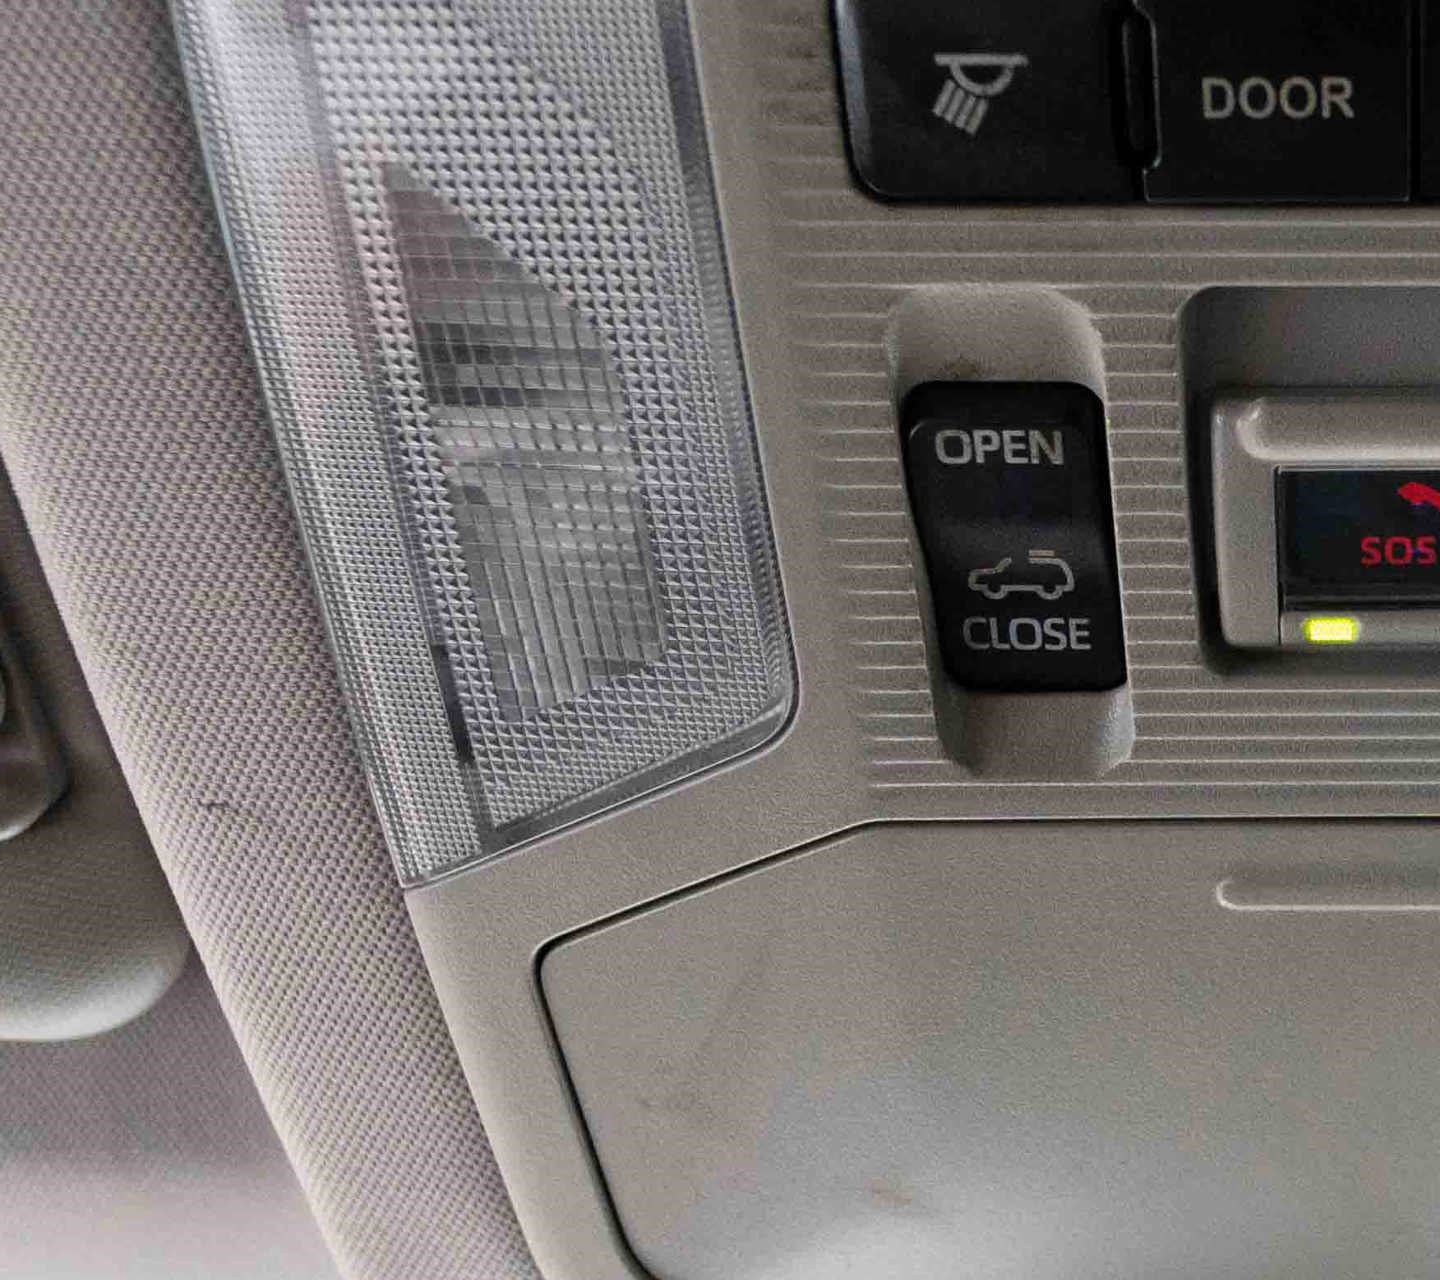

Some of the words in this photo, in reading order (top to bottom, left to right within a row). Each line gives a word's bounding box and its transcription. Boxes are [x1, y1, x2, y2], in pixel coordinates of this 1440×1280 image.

[1201, 76, 1354, 119] DOOR
[935, 429, 1064, 465] OPEN
[1359, 531, 1437, 567] SOS
[964, 616, 1092, 651] CLOSE
